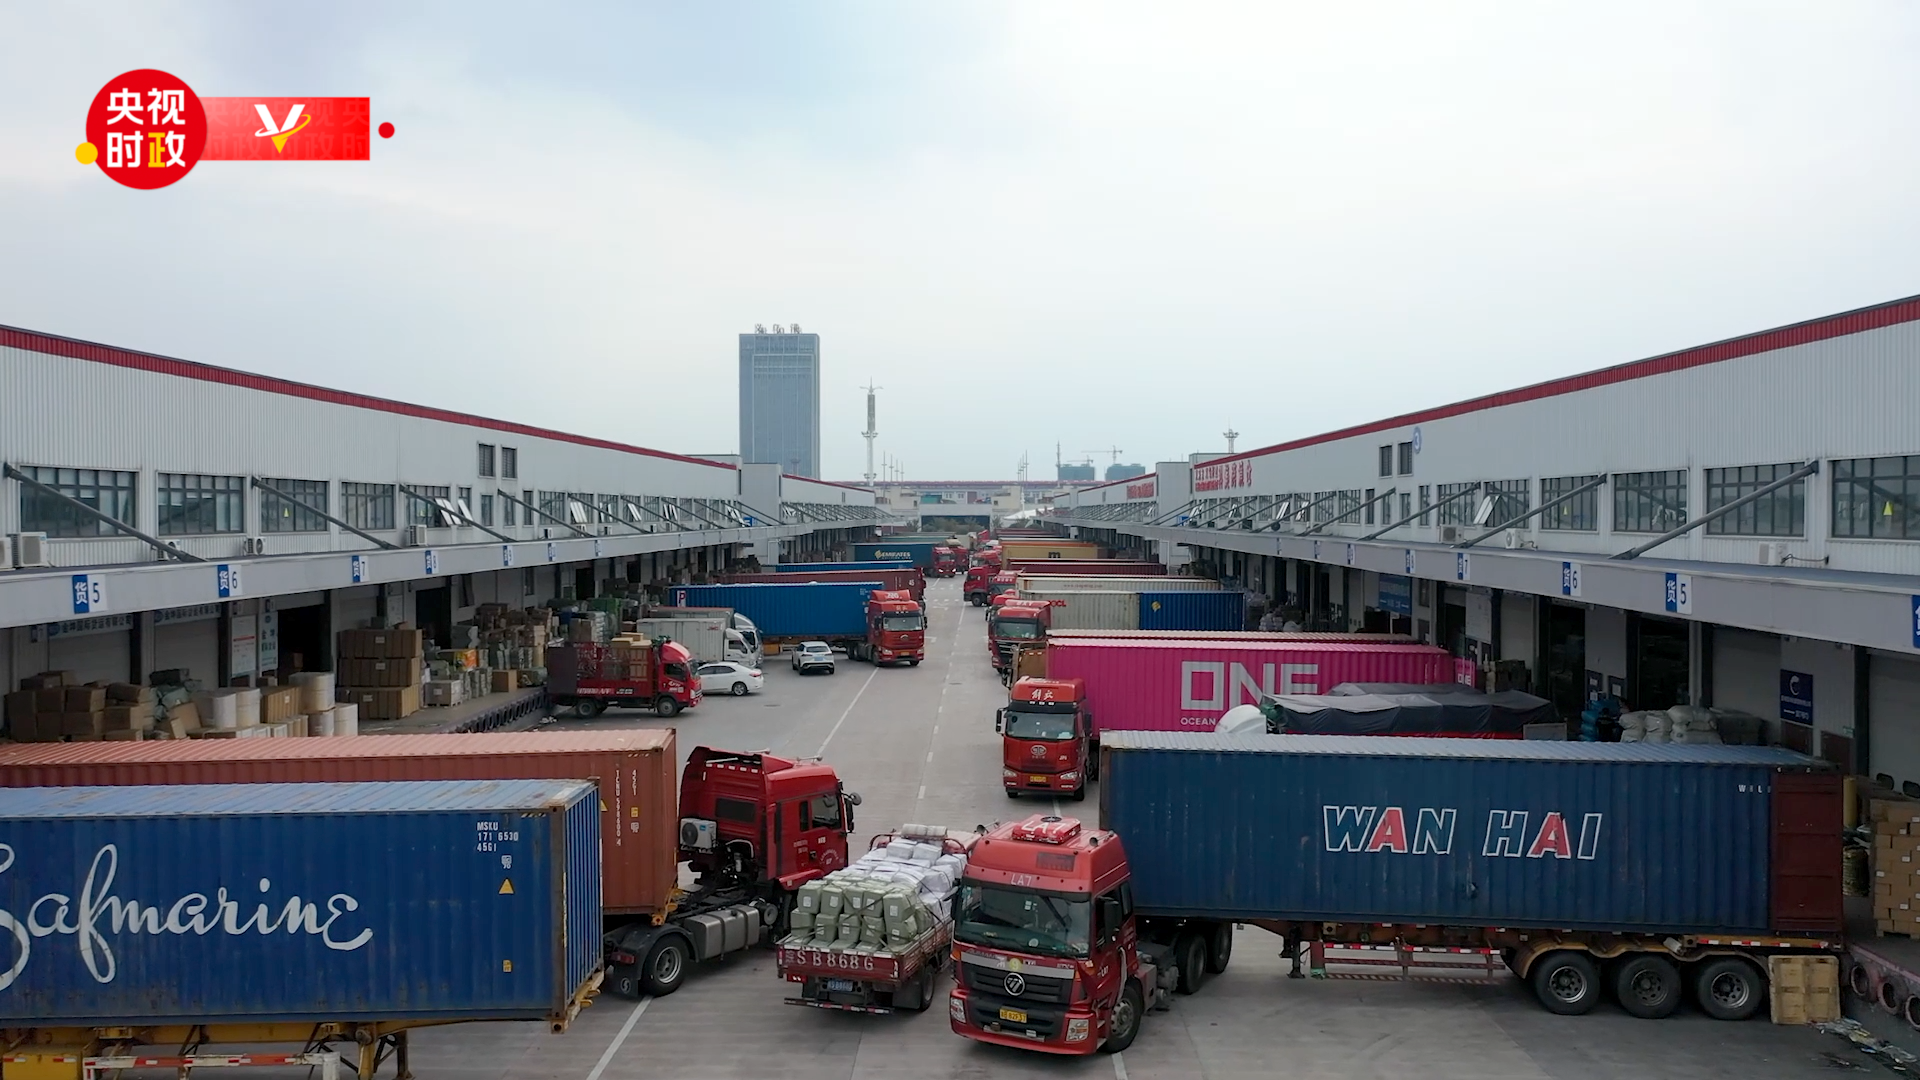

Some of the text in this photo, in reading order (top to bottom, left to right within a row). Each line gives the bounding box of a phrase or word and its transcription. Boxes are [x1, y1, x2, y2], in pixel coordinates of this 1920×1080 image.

[361, 561, 366, 576] 7
[1563, 568, 1578, 589] 货 6
[219, 570, 238, 590] 货 6
[74, 582, 100, 604] 货 5
[1666, 581, 1687, 604] 货 5
[1181, 661, 1318, 711] ONE
[1180, 717, 1216, 726] OCEAN
[477, 821, 499, 831] MSKU
[1323, 805, 1603, 860] WAN HAI
[478, 832, 519, 842] 171 6530
[1010, 874, 1032, 886] LA7
